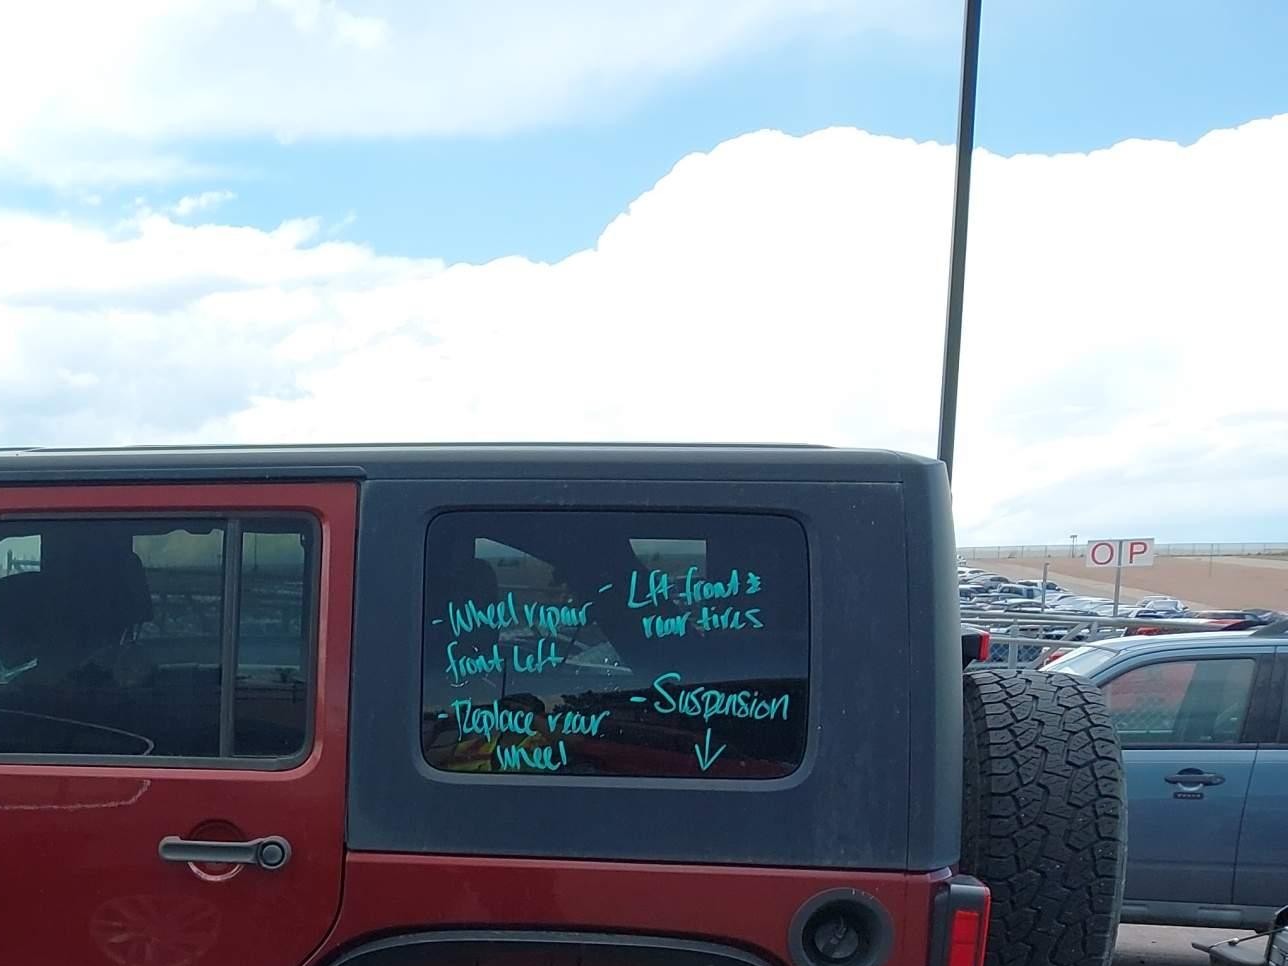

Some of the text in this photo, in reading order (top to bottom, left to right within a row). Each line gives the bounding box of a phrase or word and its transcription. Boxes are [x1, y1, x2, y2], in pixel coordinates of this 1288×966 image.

[679, 566, 740, 606] front
[449, 592, 519, 637] Wheel
[642, 606, 764, 638] rear tires
[445, 641, 505, 684] front
[653, 672, 789, 722] Suspension
[451, 698, 537, 743] Replace
[547, 710, 610, 737] rear
